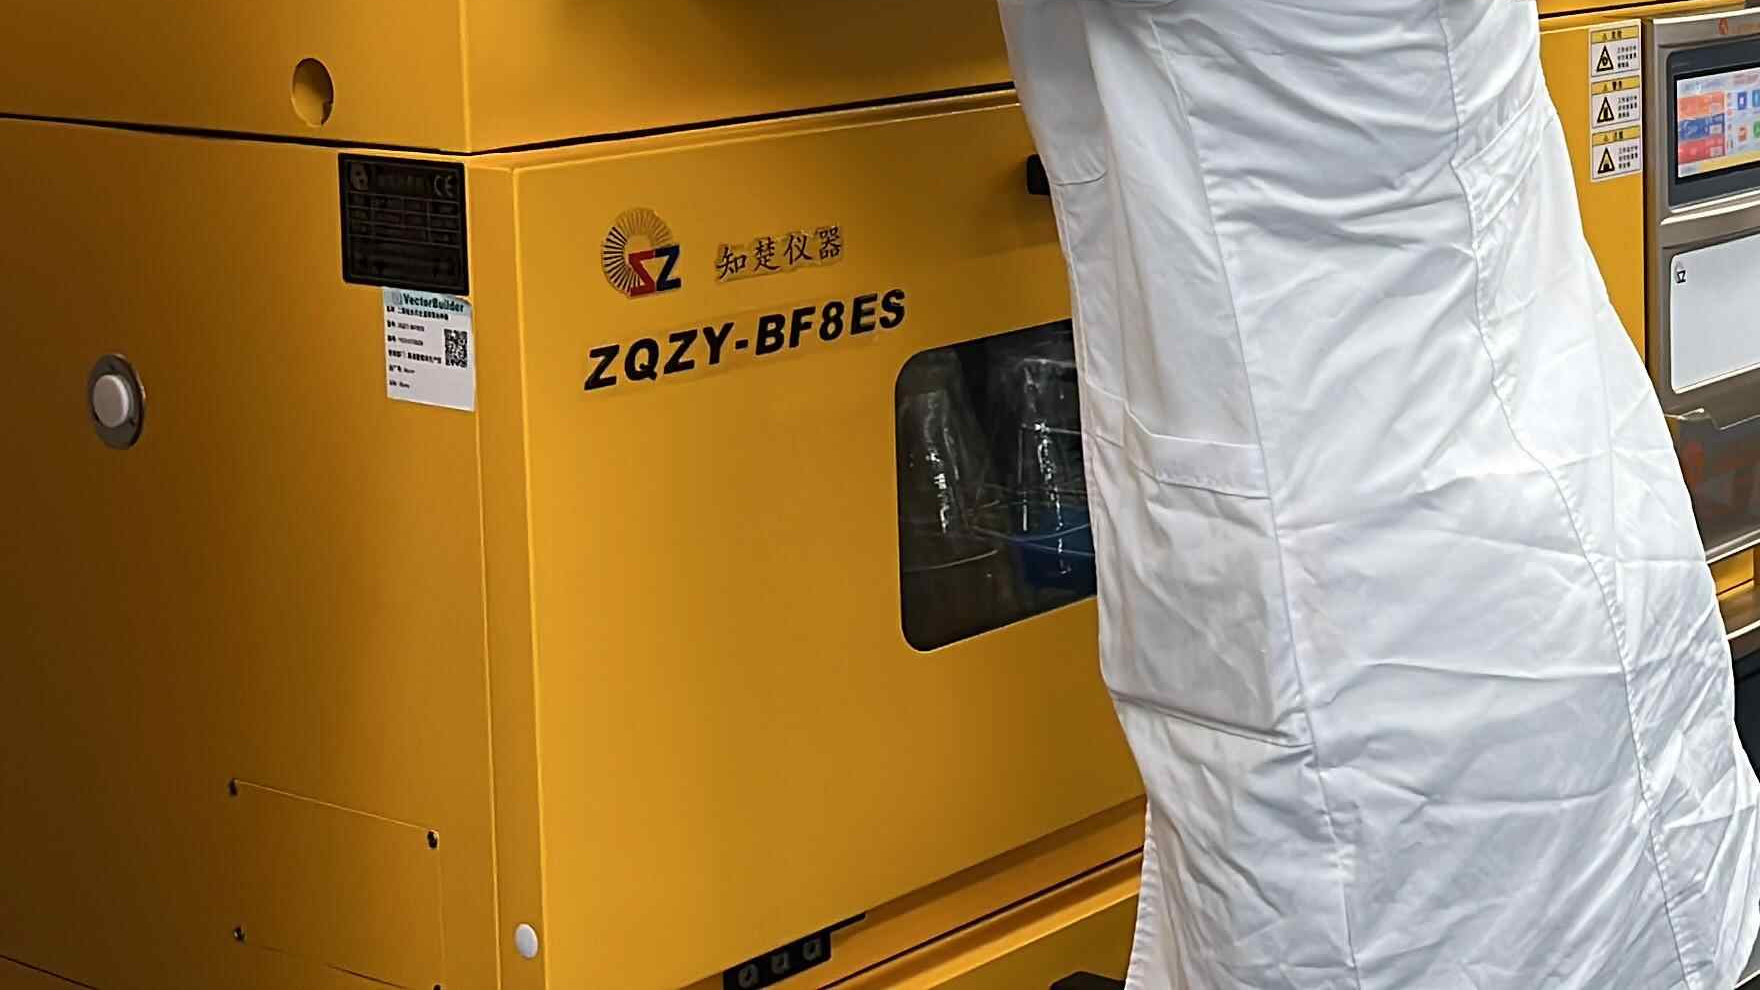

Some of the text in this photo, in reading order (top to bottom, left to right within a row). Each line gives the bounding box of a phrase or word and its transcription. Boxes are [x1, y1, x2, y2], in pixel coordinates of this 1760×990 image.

[714, 225, 842, 281] 知楚仪器
[403, 293, 464, 313] VectorBuilder
[583, 288, 906, 391] ZQZY-BF8ES
